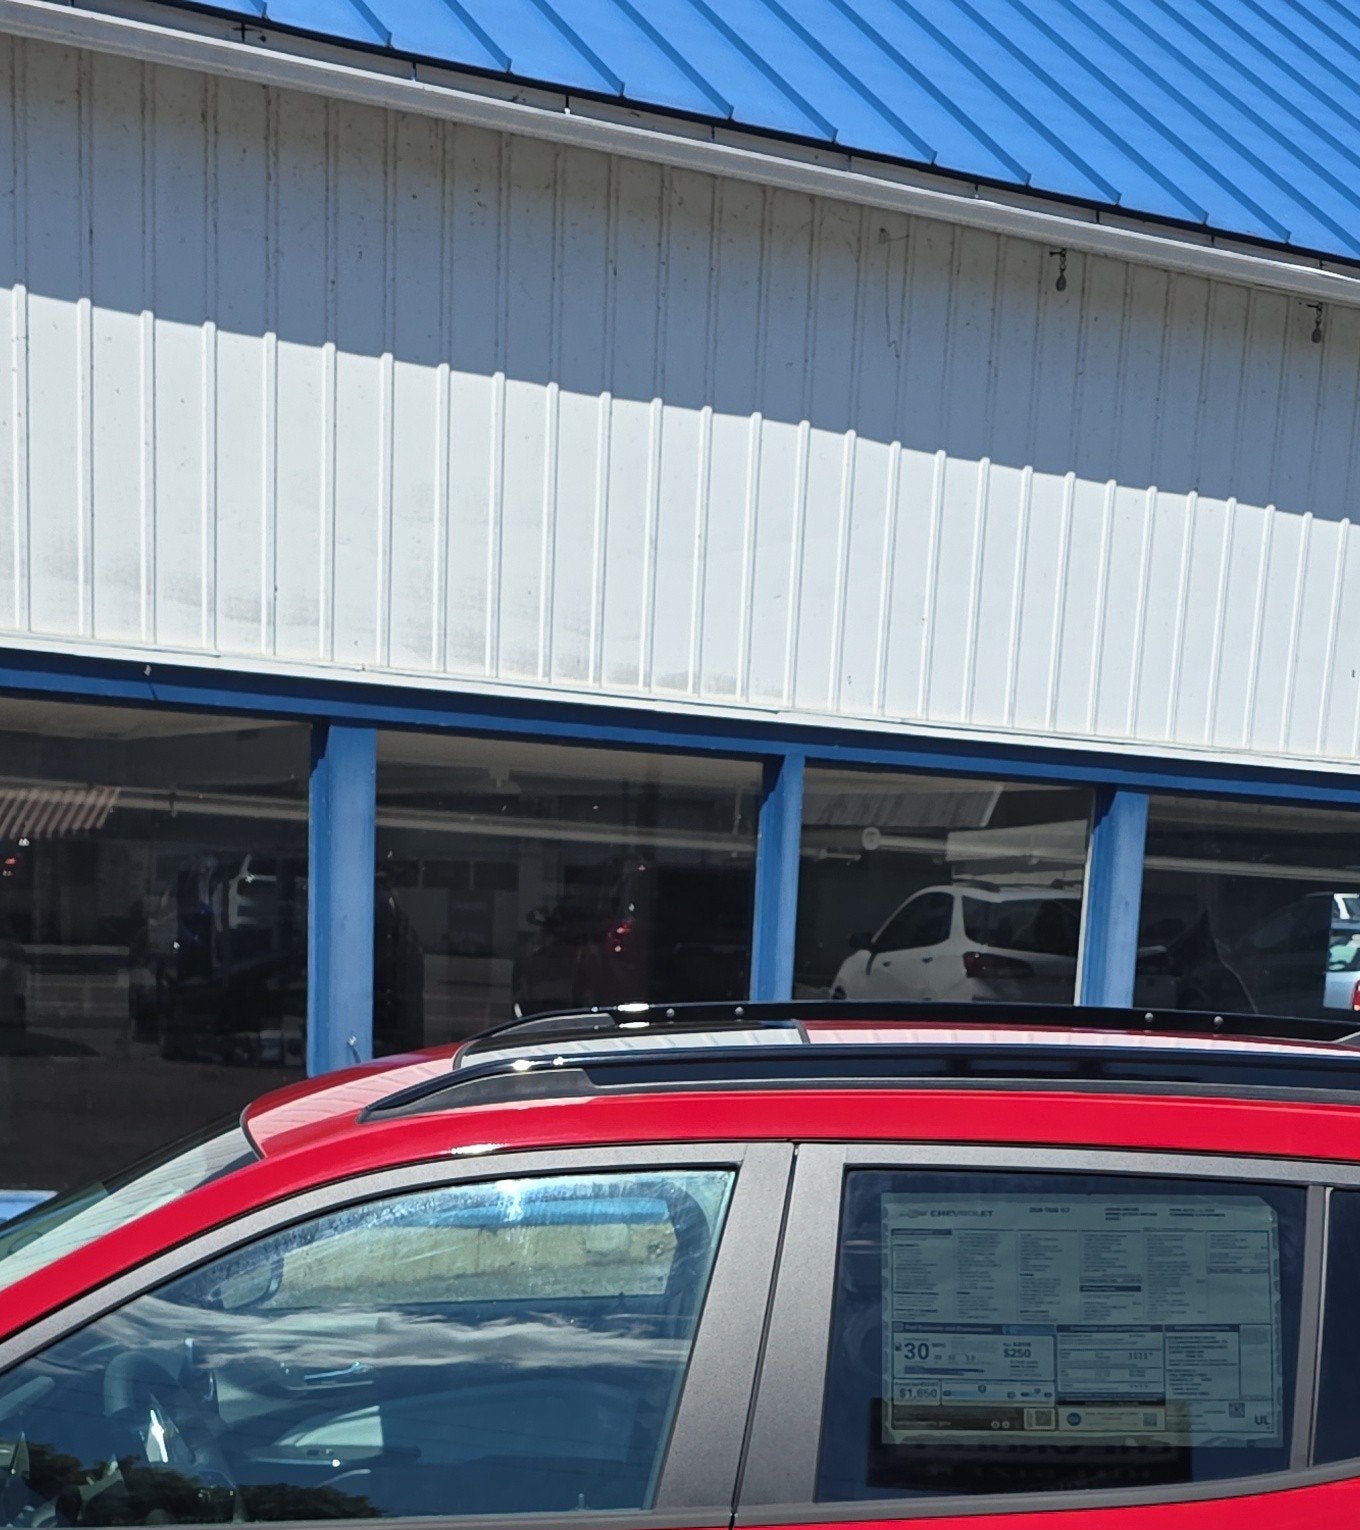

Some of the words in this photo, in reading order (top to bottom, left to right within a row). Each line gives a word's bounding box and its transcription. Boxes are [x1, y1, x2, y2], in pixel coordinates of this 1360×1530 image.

[930, 1209, 994, 1218] CHEVROLET
[904, 1342, 930, 1360] 30
[1004, 1348, 1032, 1358] $250
